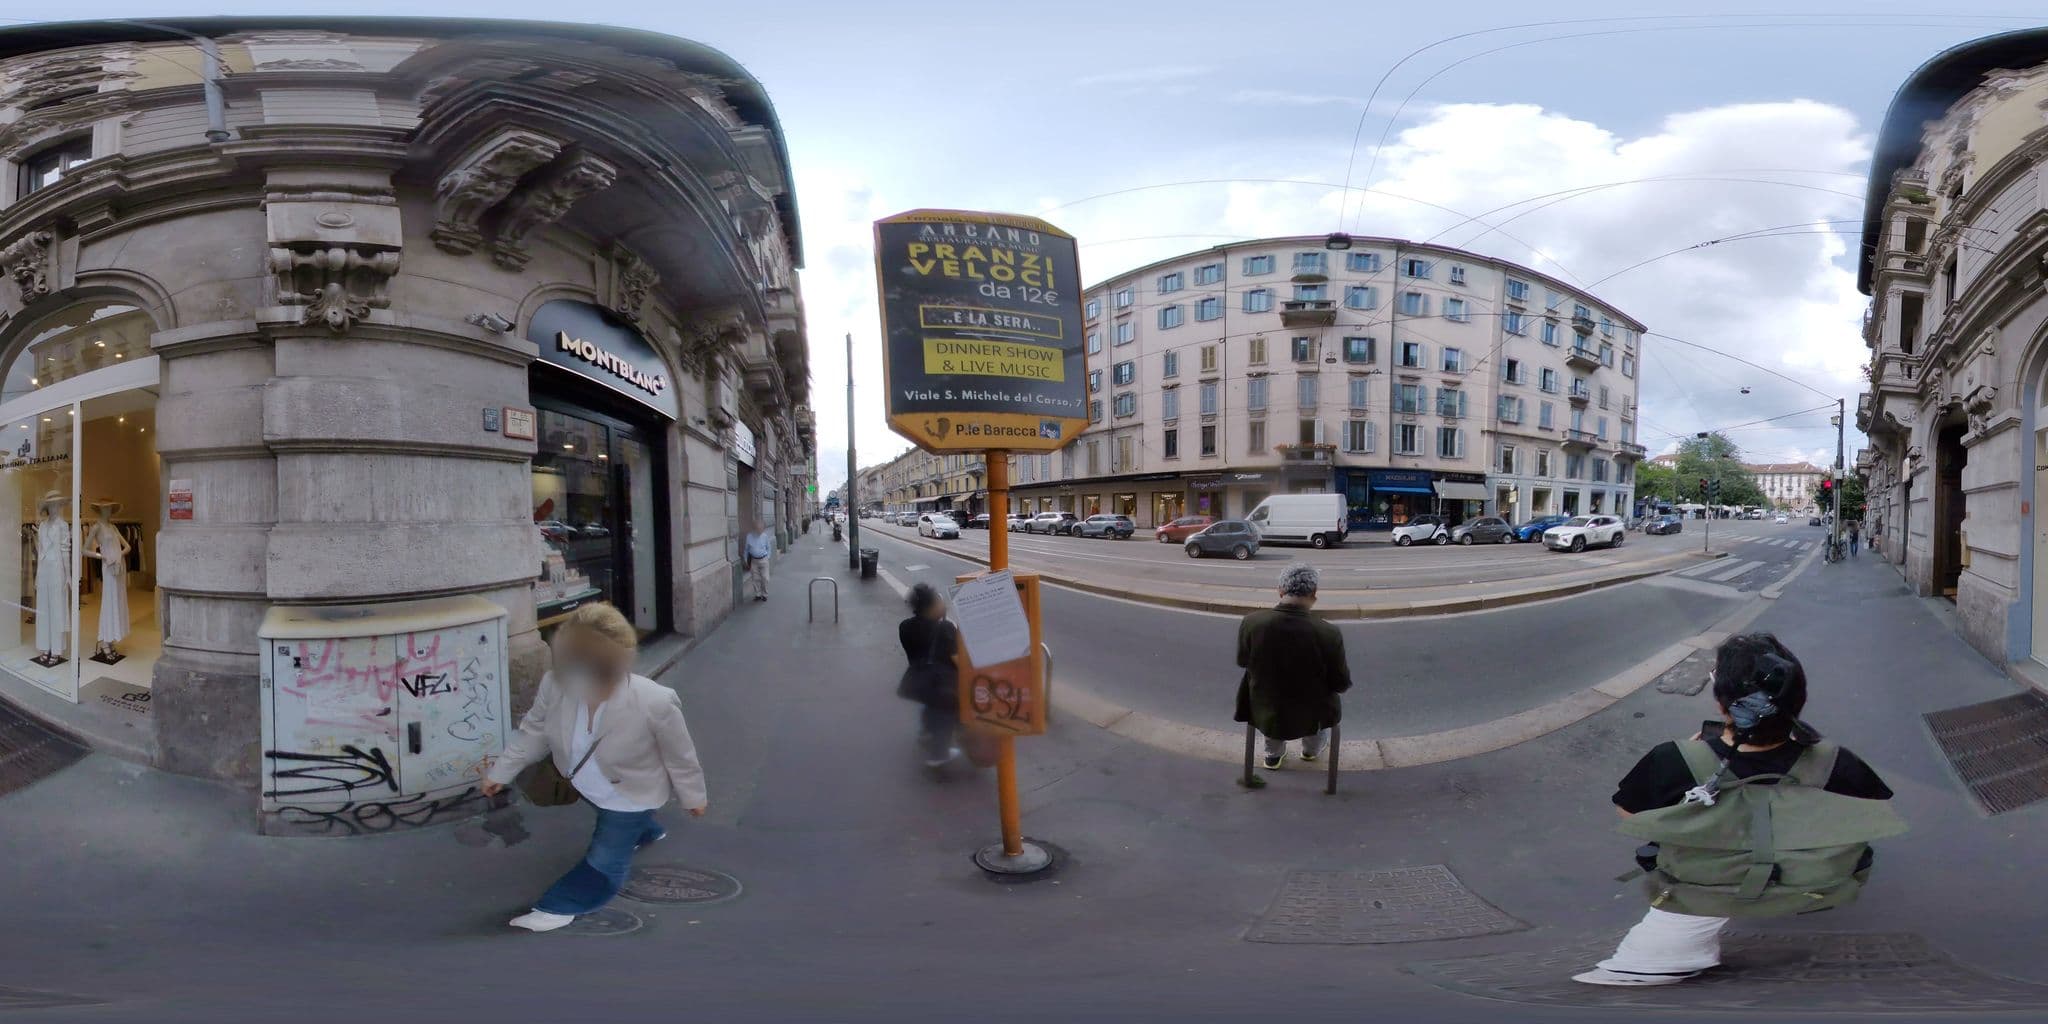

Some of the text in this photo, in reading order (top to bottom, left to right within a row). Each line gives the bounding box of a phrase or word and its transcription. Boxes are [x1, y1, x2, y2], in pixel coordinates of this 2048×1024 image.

[921, 224, 1040, 246] ARCANO
[908, 243, 1053, 273] PRANZI
[909, 259, 1054, 289] VELOCI
[980, 281, 1059, 307] da 12€
[969, 313, 987, 325] LA
[936, 342, 1054, 362] DINNER SHOW
[559, 330, 662, 397] MONTBLANC
[943, 360, 1050, 379] & LIVE MUSIC
[904, 390, 940, 401] Viale
[945, 391, 957, 400] S.
[962, 390, 1009, 402] Michele
[1014, 393, 1032, 403] del
[1076, 399, 1082, 408] 7
[956, 424, 980, 436] P.le
[984, 424, 1037, 437] Baracca
